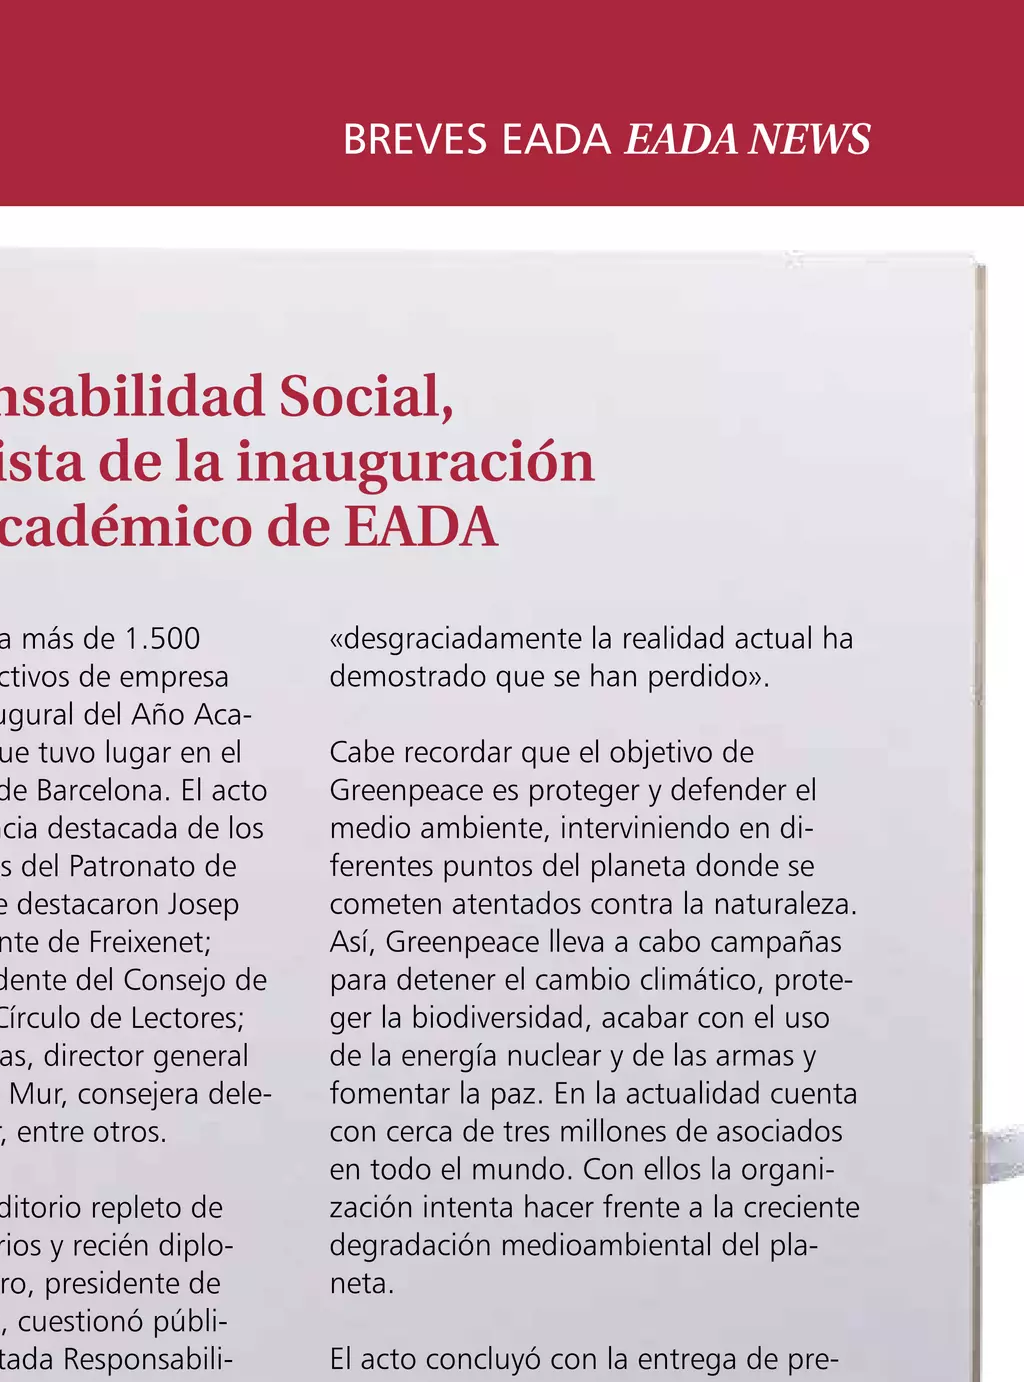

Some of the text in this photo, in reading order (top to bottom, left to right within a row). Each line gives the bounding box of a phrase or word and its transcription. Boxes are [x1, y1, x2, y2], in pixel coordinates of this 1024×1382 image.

[345, 122, 872, 155] BREVES EADA EADA NEWS
[280, 372, 453, 425] Social,
[99, 437, 162, 482] de
[175, 437, 224, 482] la
[236, 437, 596, 496] inauguración
[267, 502, 331, 547] de
[344, 505, 500, 547] EADA
[22, 625, 74, 650] más
[83, 624, 115, 650] de
[126, 626, 200, 650] 1.500
[330, 624, 853, 656] «desgraciadamente la realidad actual ha
[79, 663, 111, 688] de
[120, 670, 228, 694] empresa
[38, 742, 95, 764] tuvo
[106, 738, 172, 770] lugar
[180, 746, 211, 764] en
[221, 738, 241, 764] el
[330, 738, 754, 770] Cabe recordar que el objetivo de
[329, 852, 815, 884] ferentes puntos del planeta donde se
[48, 928, 80, 954] de
[90, 928, 211, 957] Freixenet;
[329, 927, 842, 959] Así, Greenpeace lleva a cabo campañas
[44, 1042, 145, 1067] director
[153, 1042, 248, 1074] general
[10, 1081, 67, 1109] Mur,
[78, 1080, 198, 1112] consejera
[208, 1080, 272, 1105] dele-
[329, 1079, 857, 1111] fomentar la paz. En la actualidad cuenta
[329, 1193, 860, 1219] zación intenta hacer frente a la creciente
[50, 1239, 64, 1263] y
[73, 1232, 148, 1257] recién
[158, 1231, 234, 1263] diplo-
[18, 1307, 143, 1333] cuestionó
[154, 1307, 228, 1339] públi-
[331, 1345, 839, 1377] El acto concluyó con la entrega de pre-
